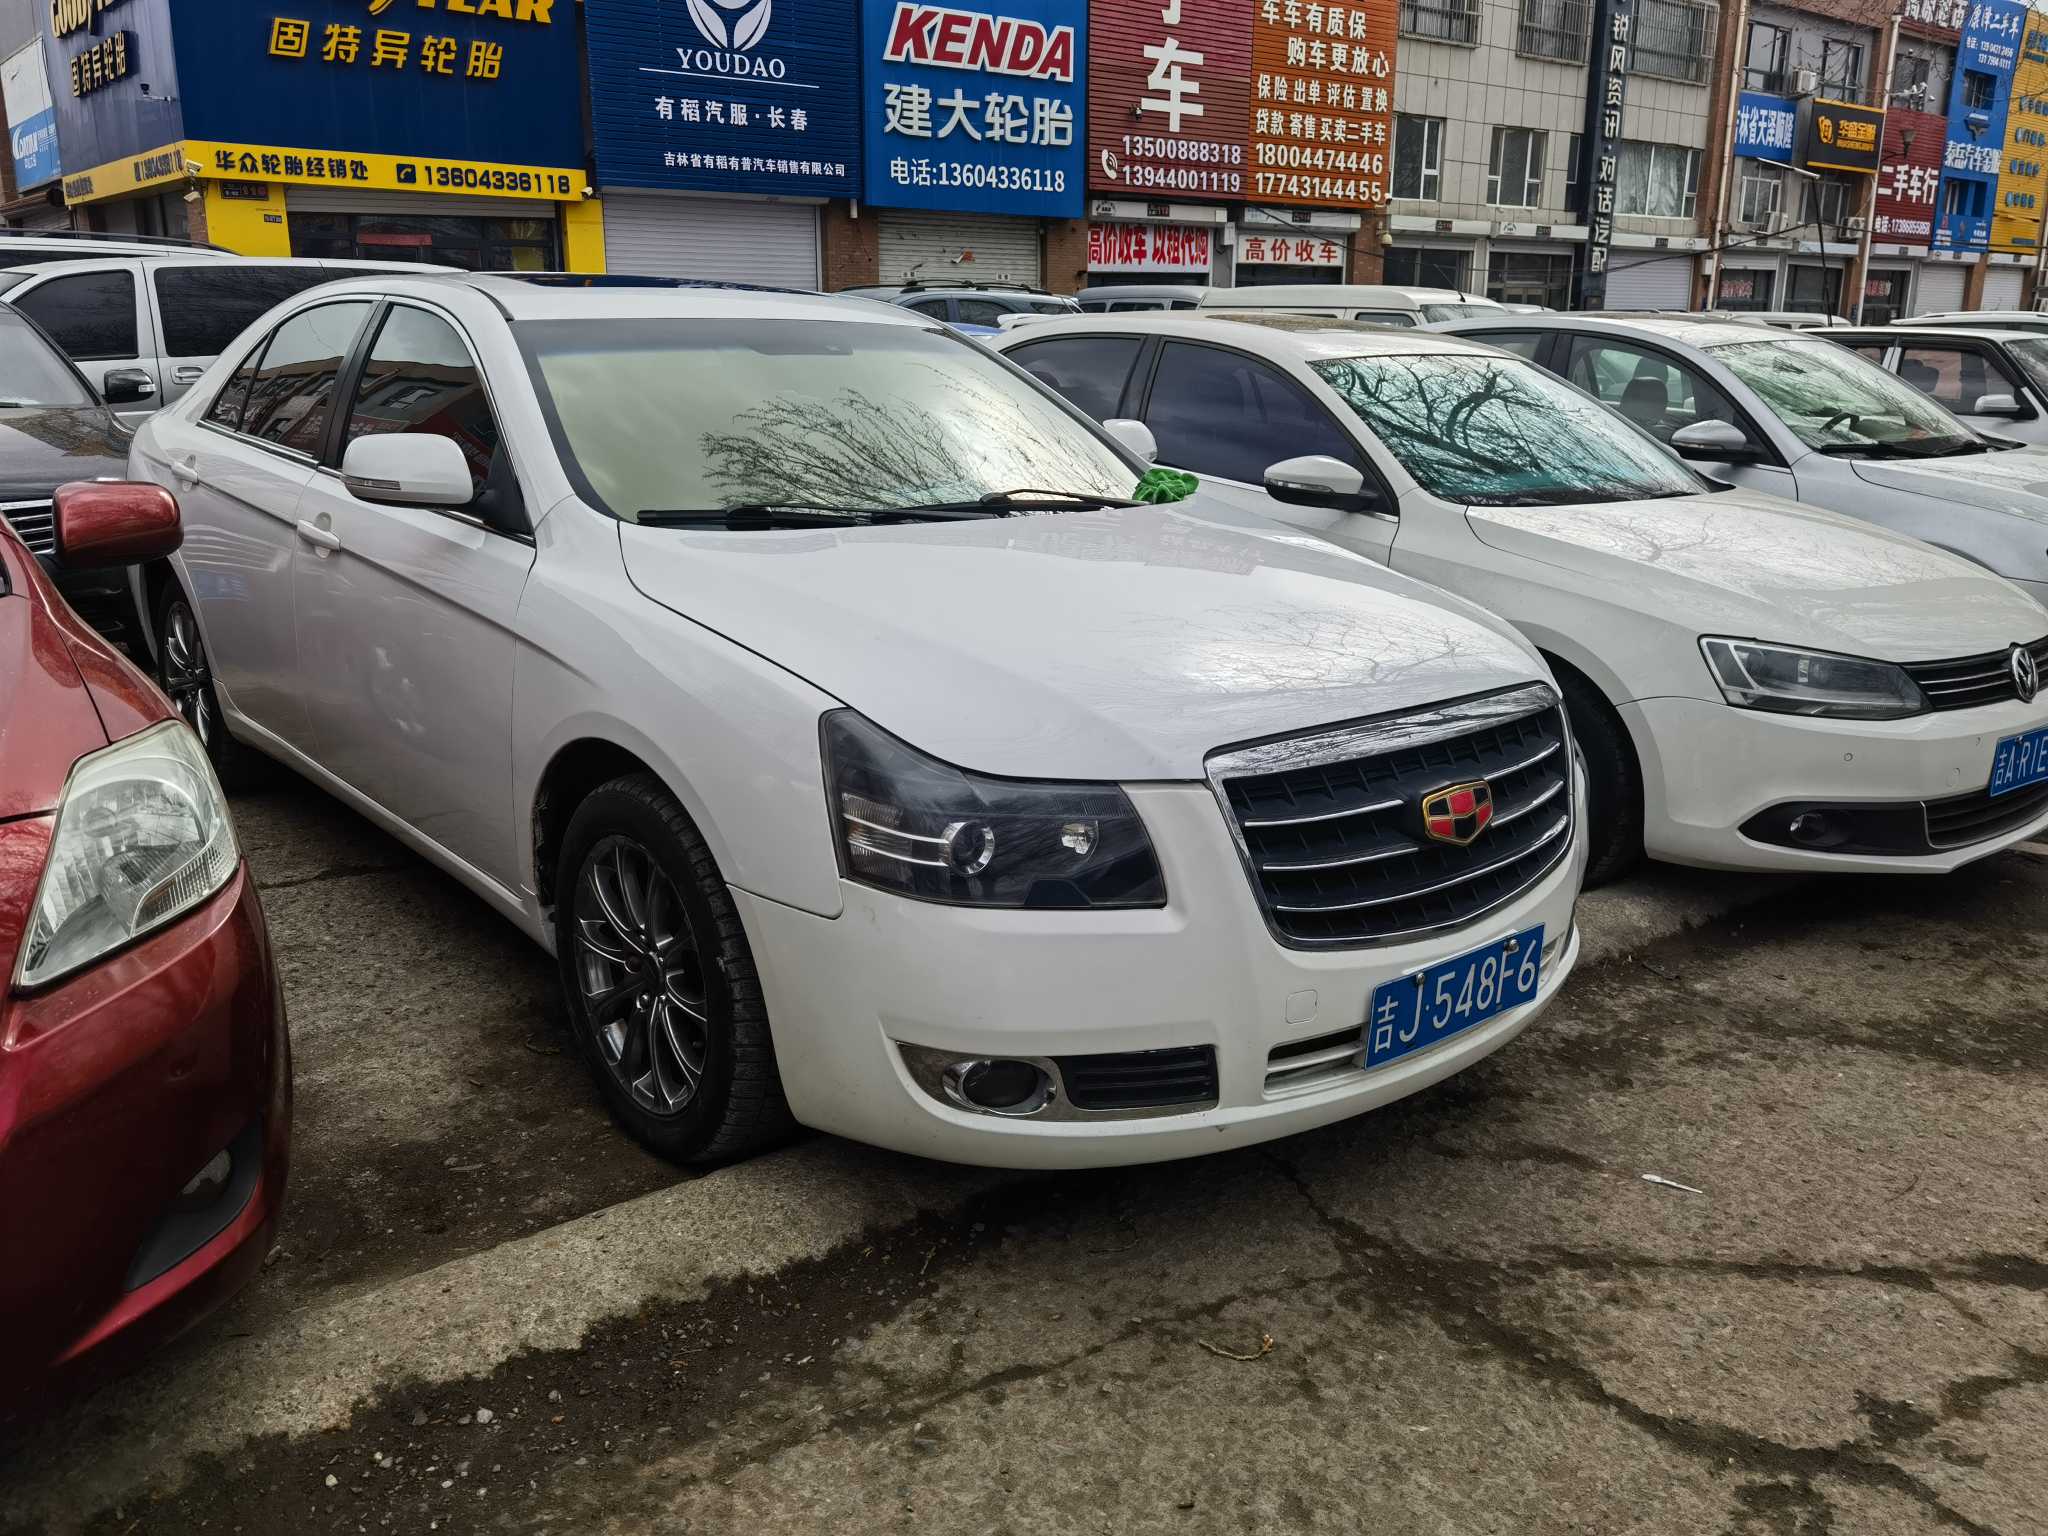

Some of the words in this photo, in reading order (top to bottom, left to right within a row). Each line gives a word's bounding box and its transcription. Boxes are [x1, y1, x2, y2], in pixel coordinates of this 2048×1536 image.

[1261, 0, 1367, 39] 车车有质保
[269, 17, 503, 79] 固特异轮胎
[883, 2, 1075, 83] KENDA
[1287, 37, 1390, 79] 购车更放心
[71, 31, 126, 97] 固特异轮胎
[676, 48, 786, 79] YOUDAO
[1257, 74, 1288, 102] 保险
[1293, 79, 1321, 105] 出单
[1327, 83, 1357, 109] 评估
[1361, 87, 1389, 113] 置换
[883, 83, 1074, 146] 建大轮胎
[1256, 109, 1285, 136] 贷款
[1289, 112, 1317, 139] 寄售
[1320, 118, 1387, 146] 买卖二手车
[1734, 104, 1795, 149] 林省天泽顺隆
[1122, 135, 1241, 165] 13500888318
[1255, 142, 1383, 175] 18004474446
[215, 150, 369, 181] 华众轮胎经销处
[424, 165, 571, 194] 13604336118
[890, 156, 1065, 193] 电话:13604336118
[1122, 165, 1241, 193] 13944001119
[1255, 173, 1382, 203] 17743144455
[1878, 164, 1939, 205] 二手车行
[1087, 223, 1148, 266] 高价收车
[1245, 237, 1339, 264] 高价收车
